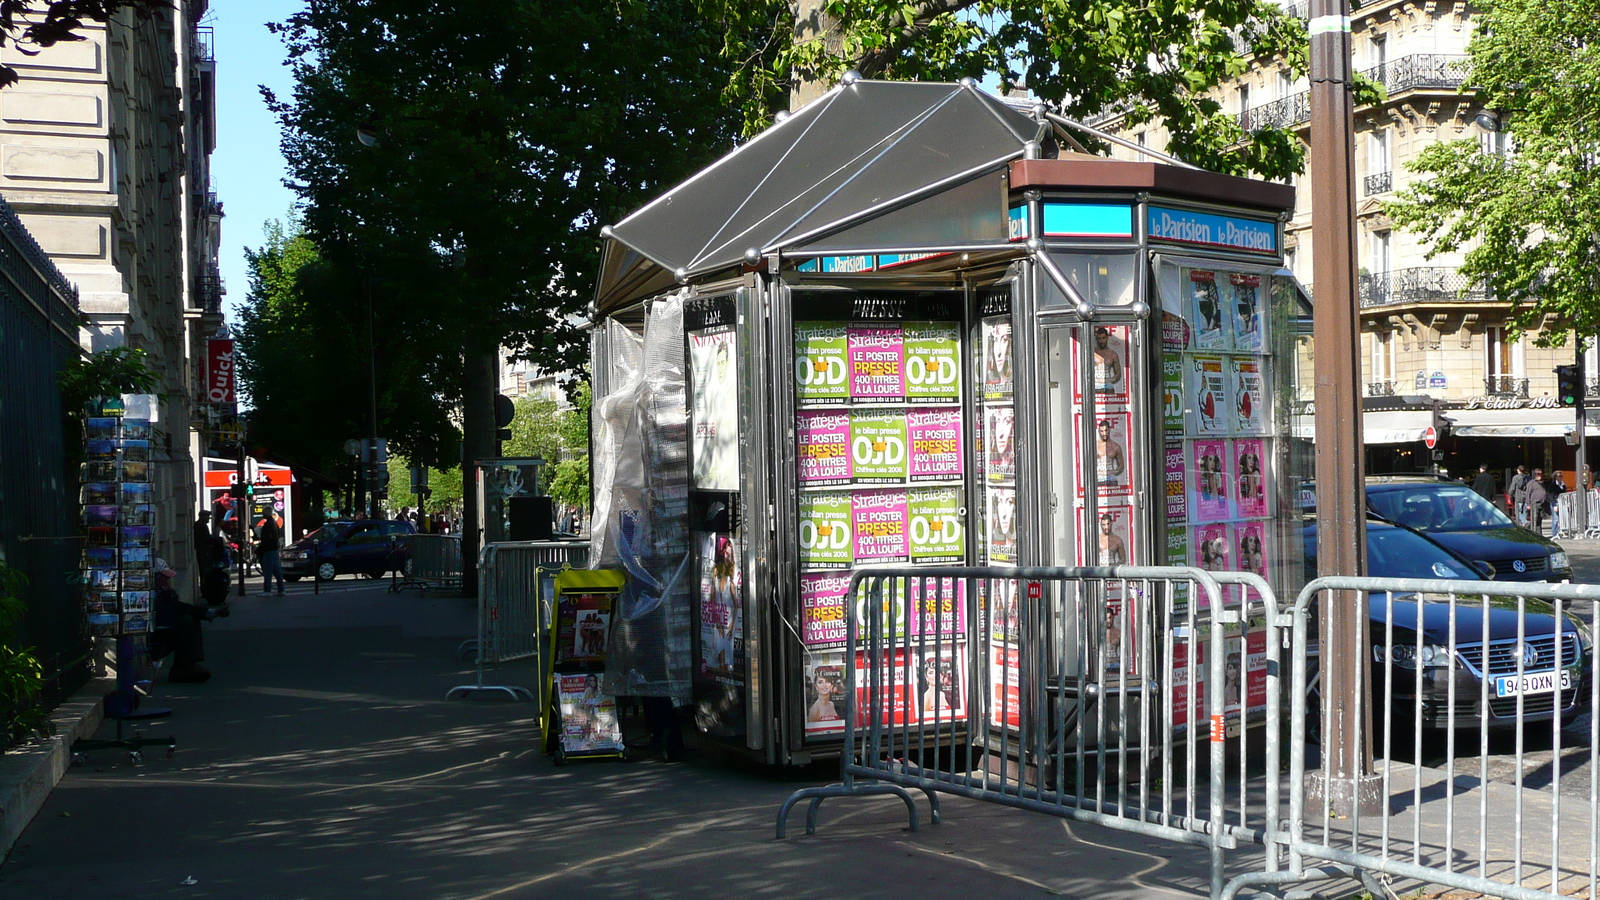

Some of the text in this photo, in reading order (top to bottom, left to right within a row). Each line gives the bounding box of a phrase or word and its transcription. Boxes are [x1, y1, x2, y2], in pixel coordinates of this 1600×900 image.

[1153, 213, 1270, 250] le Parisien le Parisien
[854, 352, 898, 361] LE POSTER
[796, 356, 846, 385] OJD
[854, 362, 899, 374] PRESSE
[906, 356, 956, 385] OJD
[210, 351, 233, 402] Quick
[872, 376, 899, 384] TITRES
[862, 385, 872, 394] LA
[874, 385, 900, 394] LOUPE
[880, 428, 900, 436] presse
[913, 430, 956, 439] LE POSTER
[800, 434, 845, 444] LE POSTER
[801, 444, 846, 457] PRESSE
[852, 436, 904, 465] OJD
[913, 440, 956, 452] PRESSE
[801, 457, 846, 467] 400 TITRES
[914, 453, 957, 462] 400 TITRES
[821, 467, 847, 476] LOUPE
[922, 463, 931, 471] LA
[933, 461, 958, 471] LOUPE
[1166, 472, 1182, 481] OSTER
[909, 487, 956, 503] Stratégie
[857, 511, 902, 522] LE POSTER
[858, 522, 903, 535] PRESSE
[910, 515, 960, 544] OJD
[800, 520, 850, 549] OJD
[858, 535, 903, 545] 400 TITRES
[867, 546, 876, 554] LA
[877, 545, 904, 554] LOUPE
[804, 595, 844, 607] LE POSTE
[806, 606, 844, 622] PRESS
[806, 620, 847, 631] 400 TITRE
[814, 631, 824, 640] LA
[826, 629, 847, 639] LOUP
[1532, 675, 1552, 690] QXN
